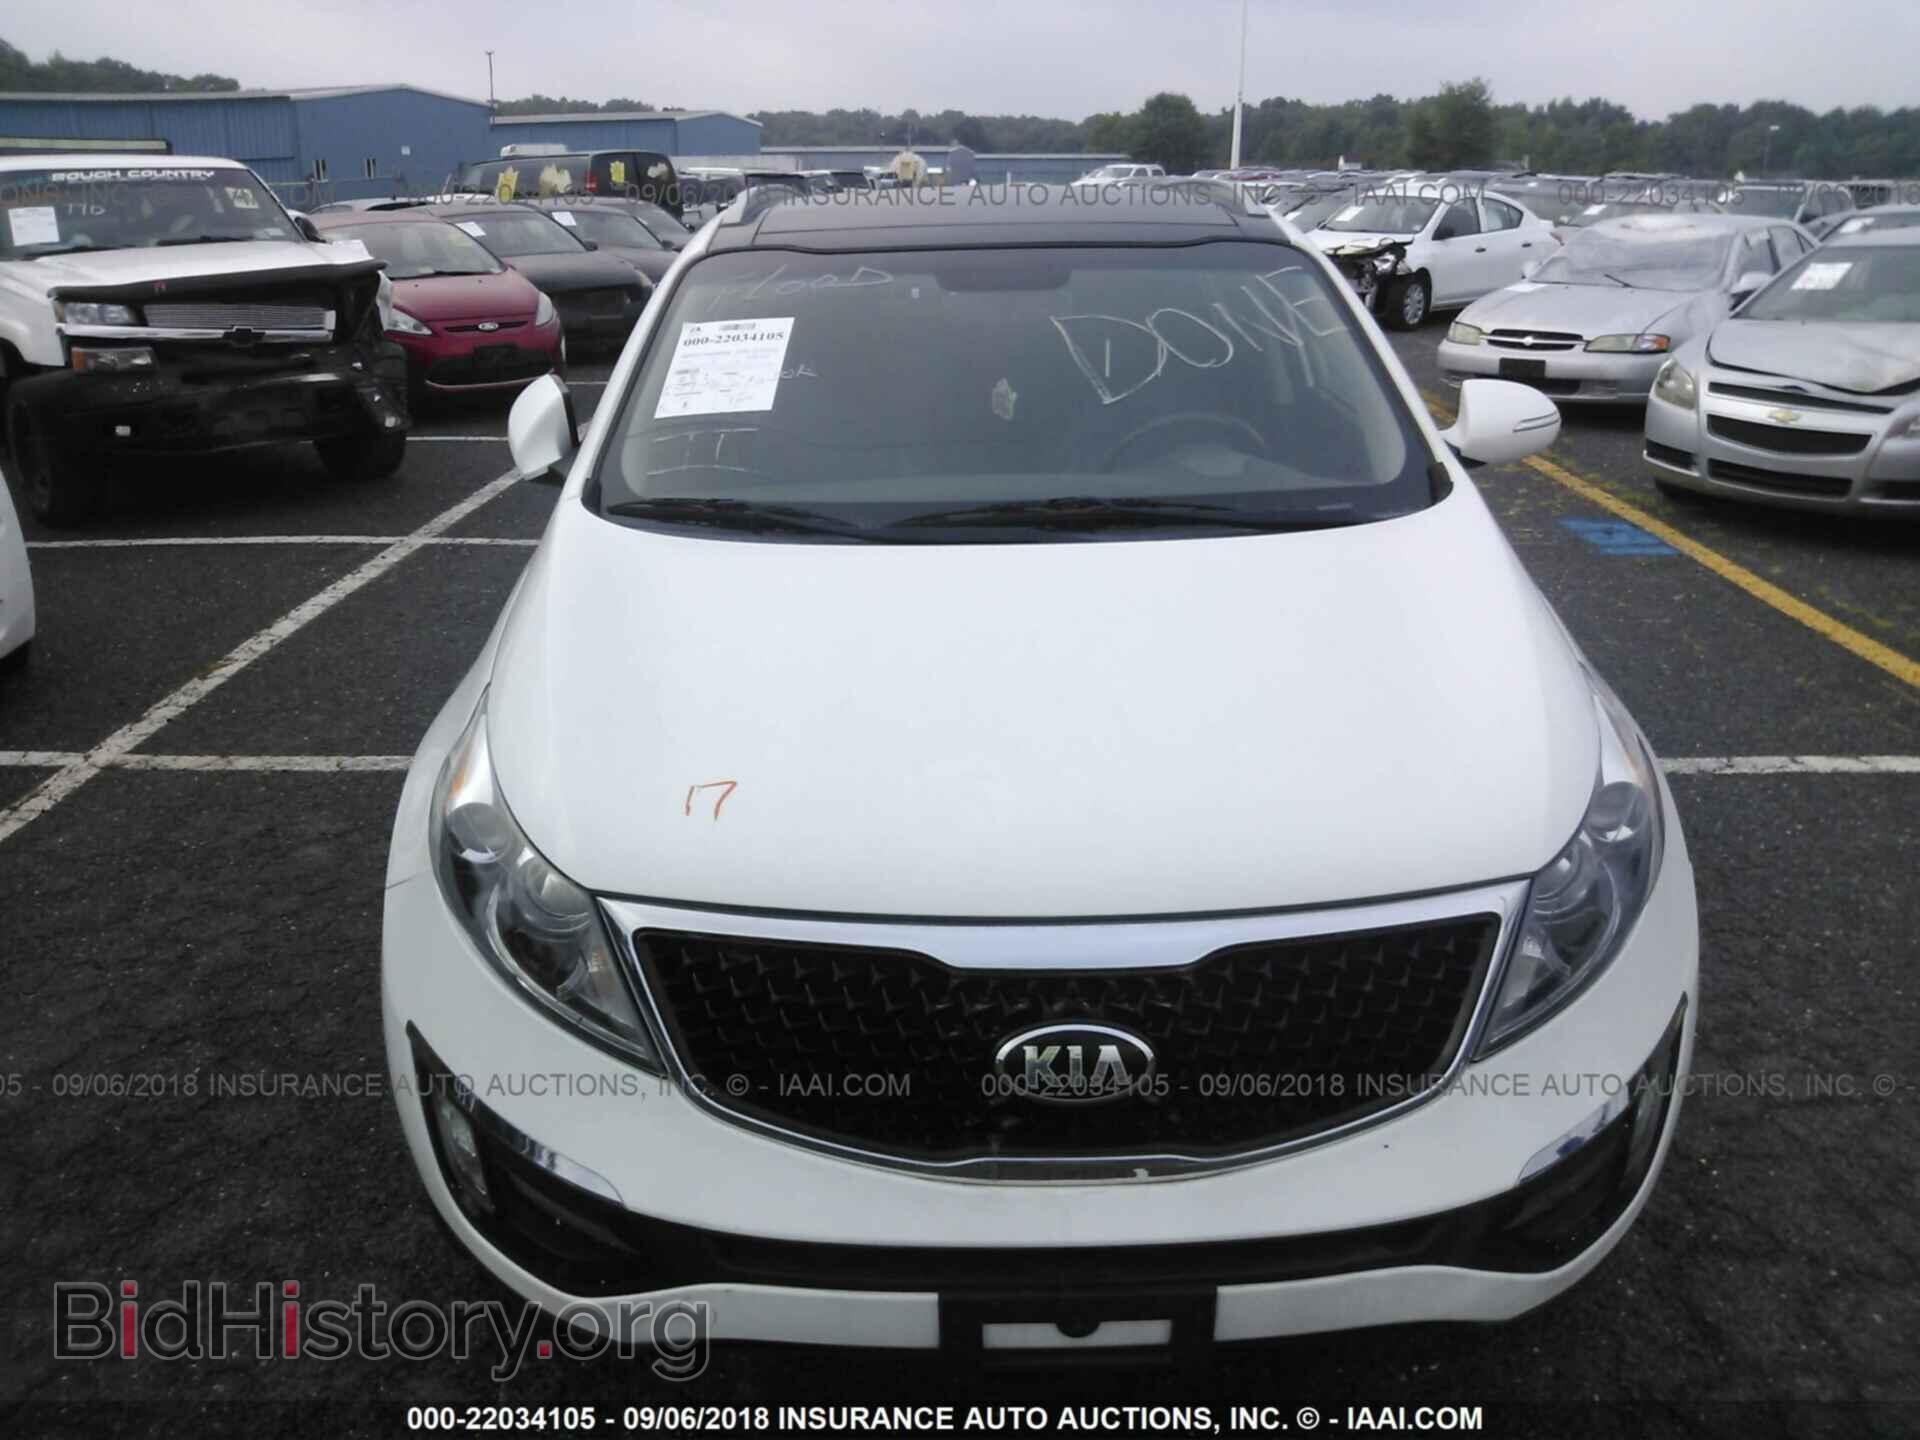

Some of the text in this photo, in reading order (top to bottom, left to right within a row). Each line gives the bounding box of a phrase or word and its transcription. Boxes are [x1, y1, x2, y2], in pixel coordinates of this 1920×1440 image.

[51, 169, 215, 180] ROUGH COUNTRY
[682, 330, 785, 347] 000-22034105
[1023, 1044, 1130, 1088] KIA
